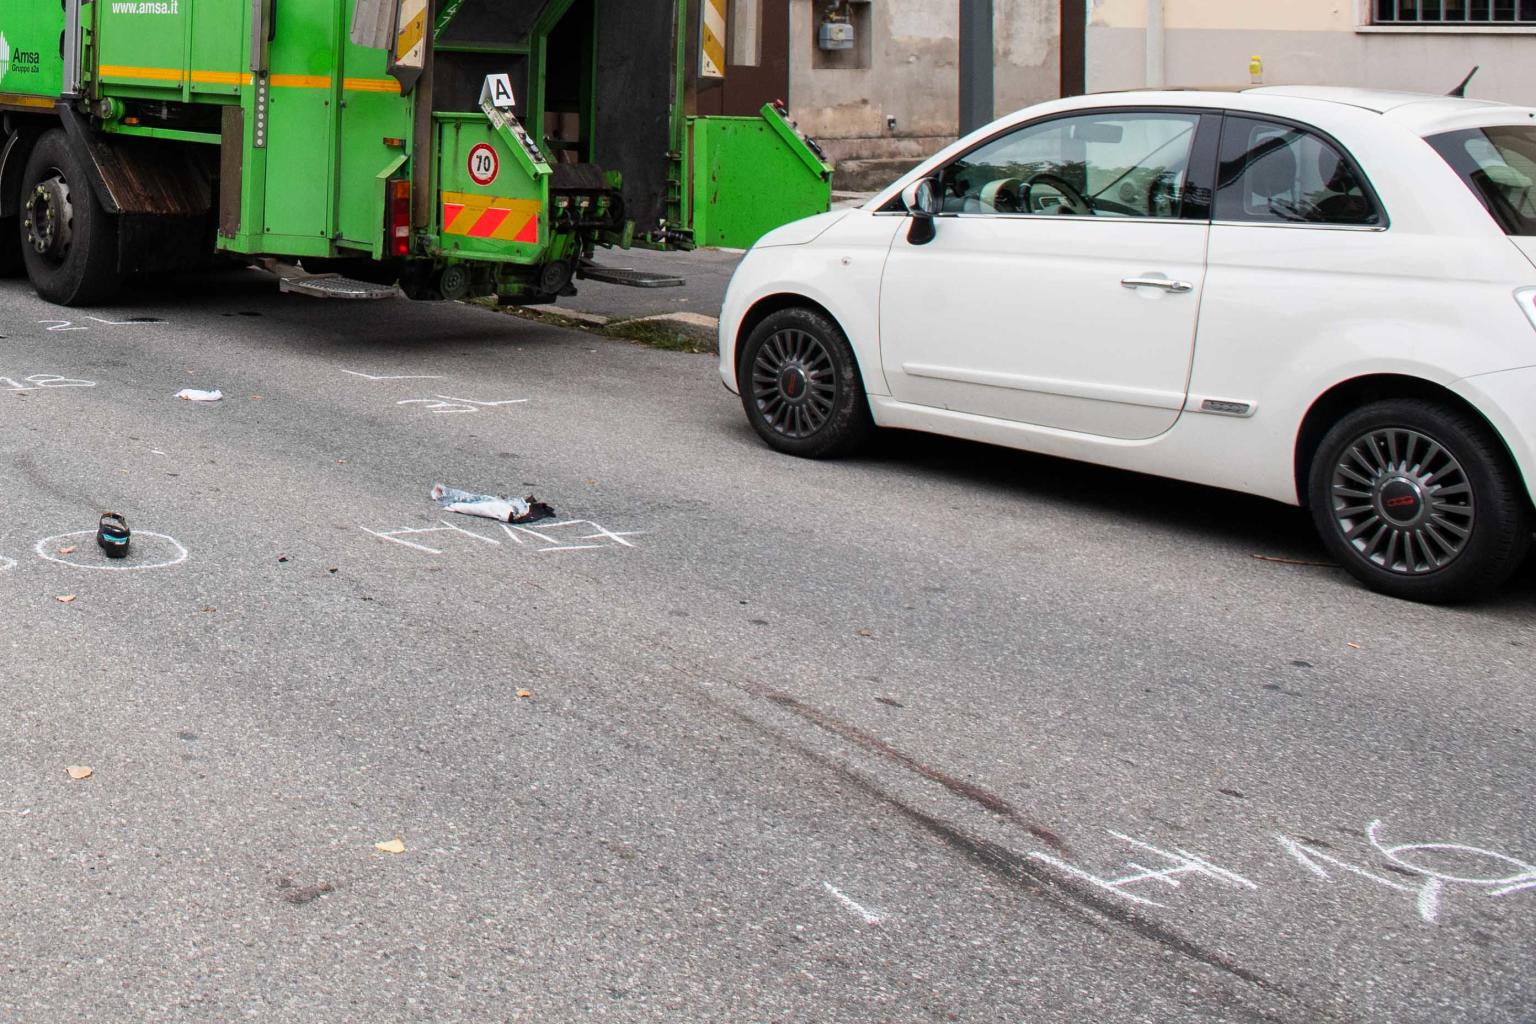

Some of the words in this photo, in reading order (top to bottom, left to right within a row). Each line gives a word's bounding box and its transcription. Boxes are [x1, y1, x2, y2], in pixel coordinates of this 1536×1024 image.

[112, 0, 179, 15] www.amsa.it
[12, 48, 40, 64] Amsa
[11, 63, 31, 74] Gruppo
[495, 79, 511, 100] A
[476, 155, 492, 173] 70
